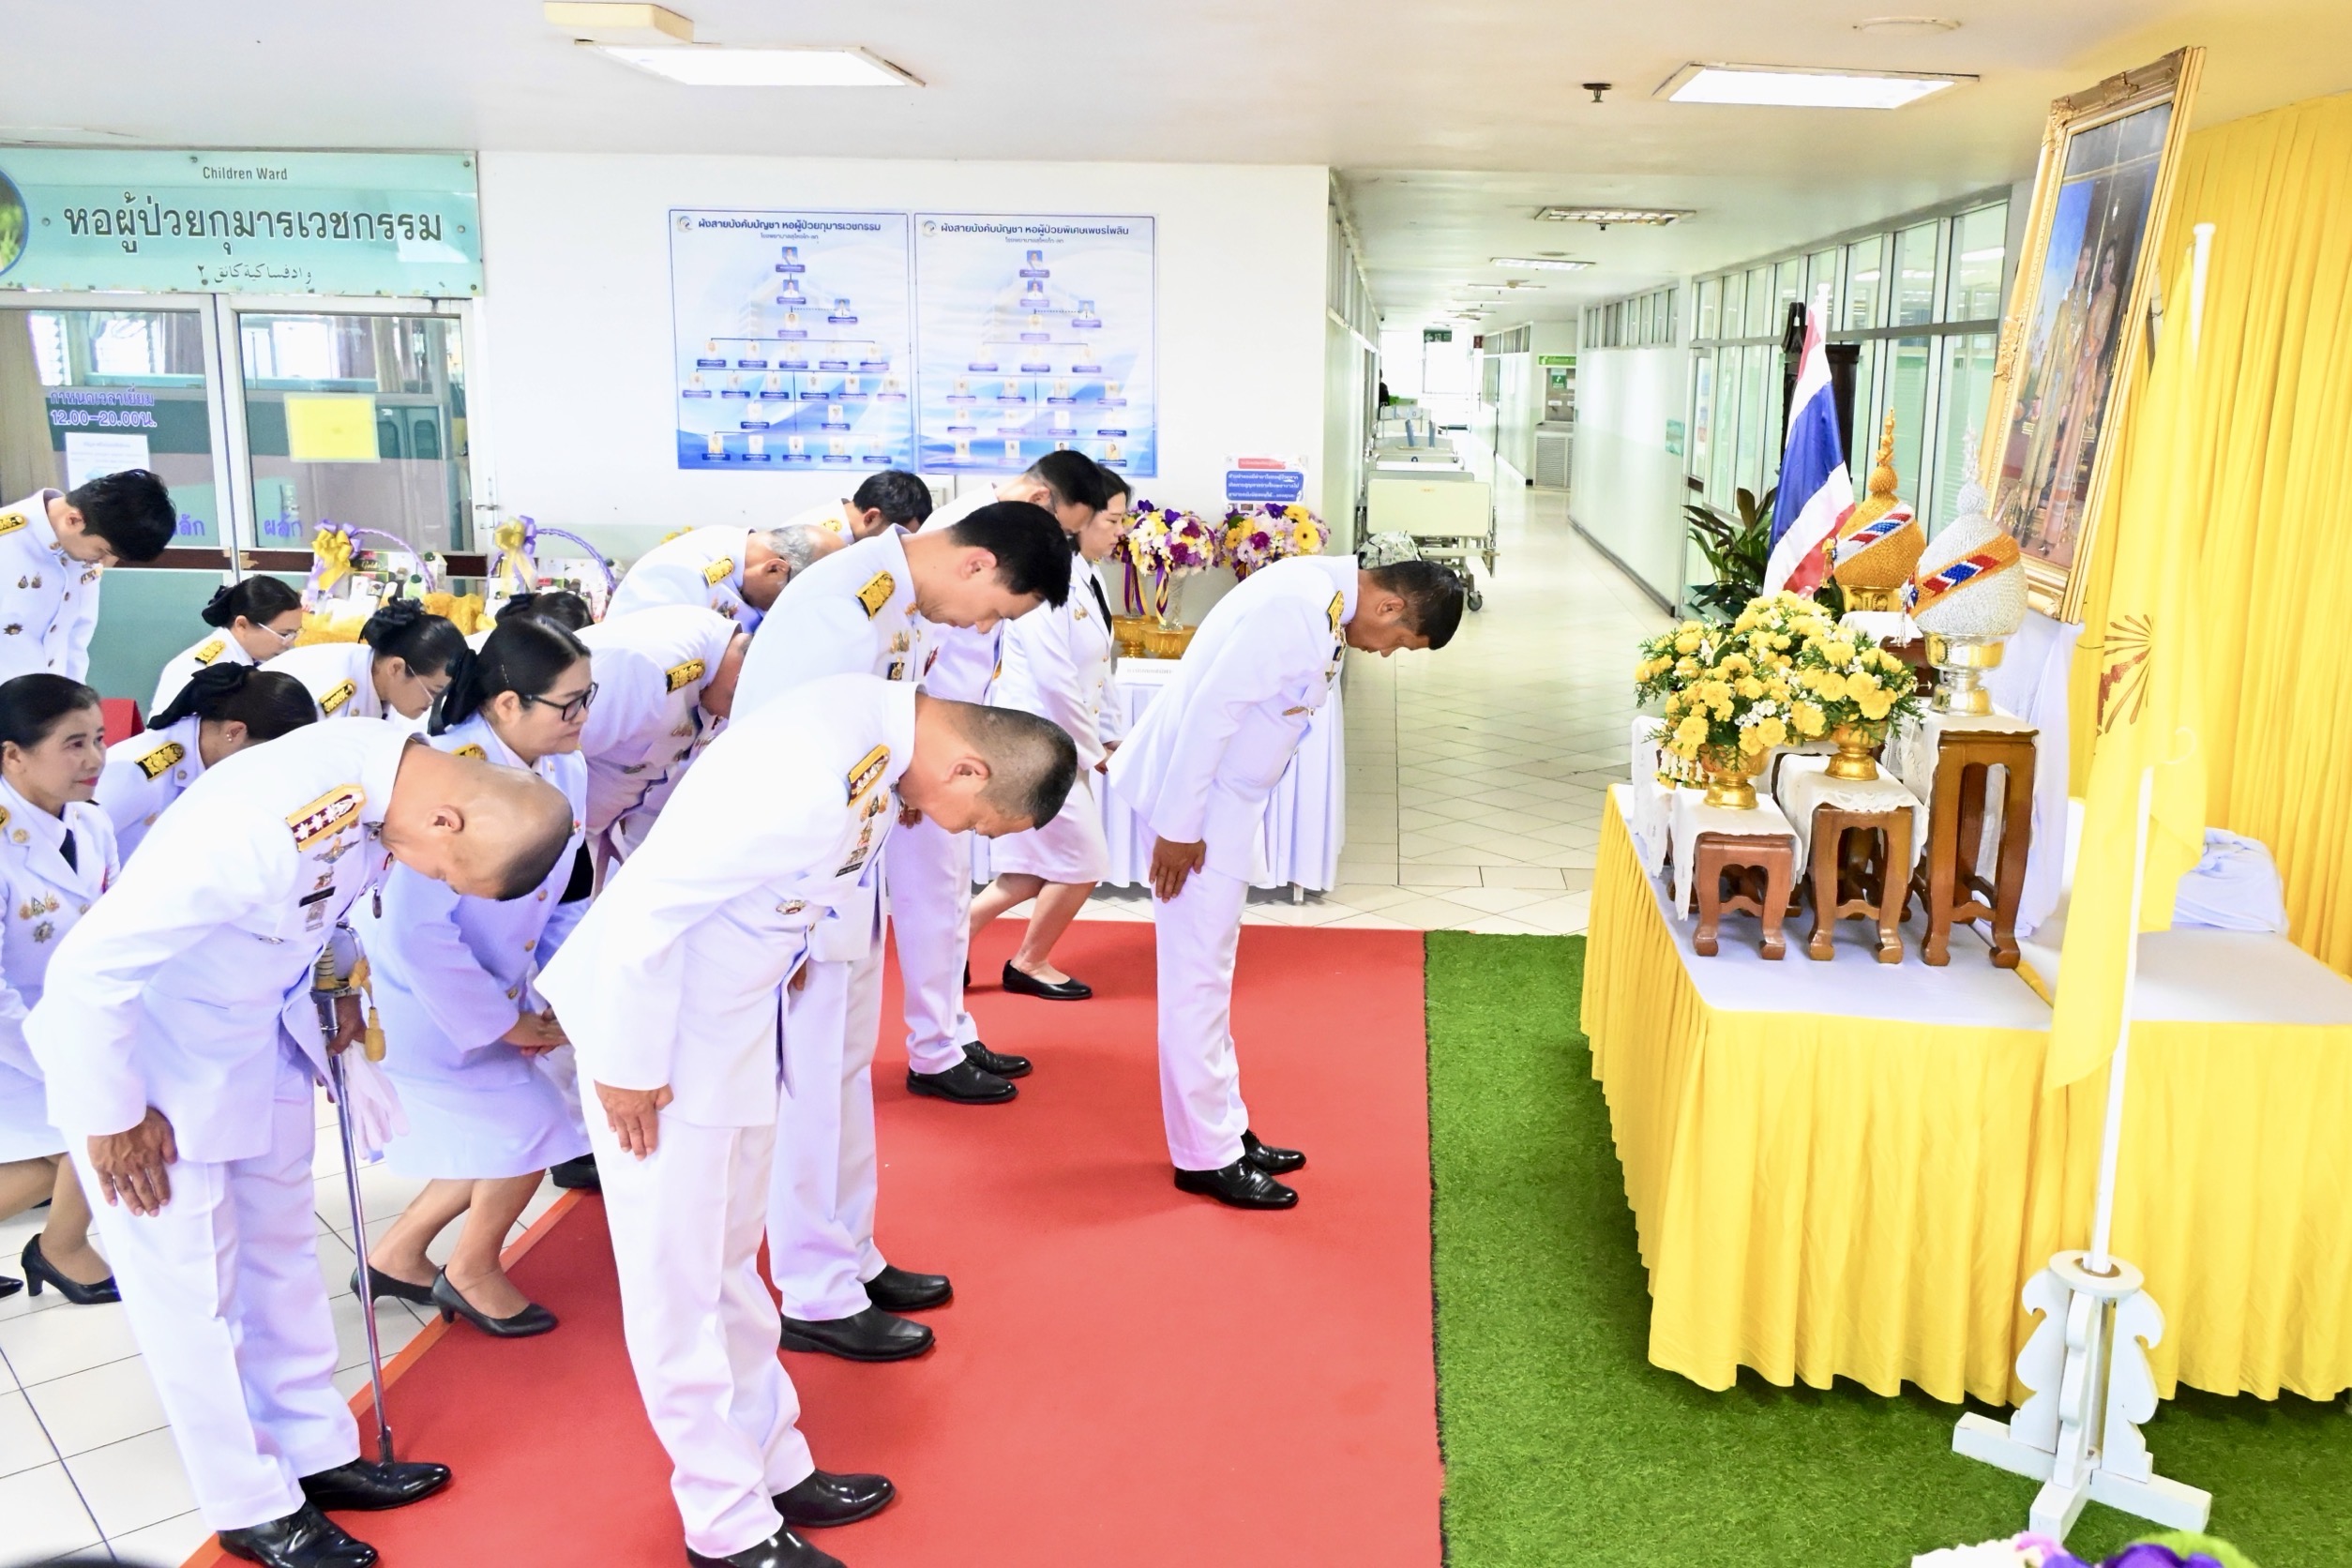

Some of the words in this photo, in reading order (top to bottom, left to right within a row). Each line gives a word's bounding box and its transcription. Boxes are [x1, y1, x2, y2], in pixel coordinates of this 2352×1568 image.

[203, 166, 253, 180] Children
[256, 167, 288, 180] Ward
[63, 190, 443, 255] หอผู้ป่วยกุมารเวชกรรม
[782, 219, 882, 233] หอผู้ป่วยกุมารเวชกรรม
[50, 383, 155, 407] กำหนดเวลาเยี่ยม
